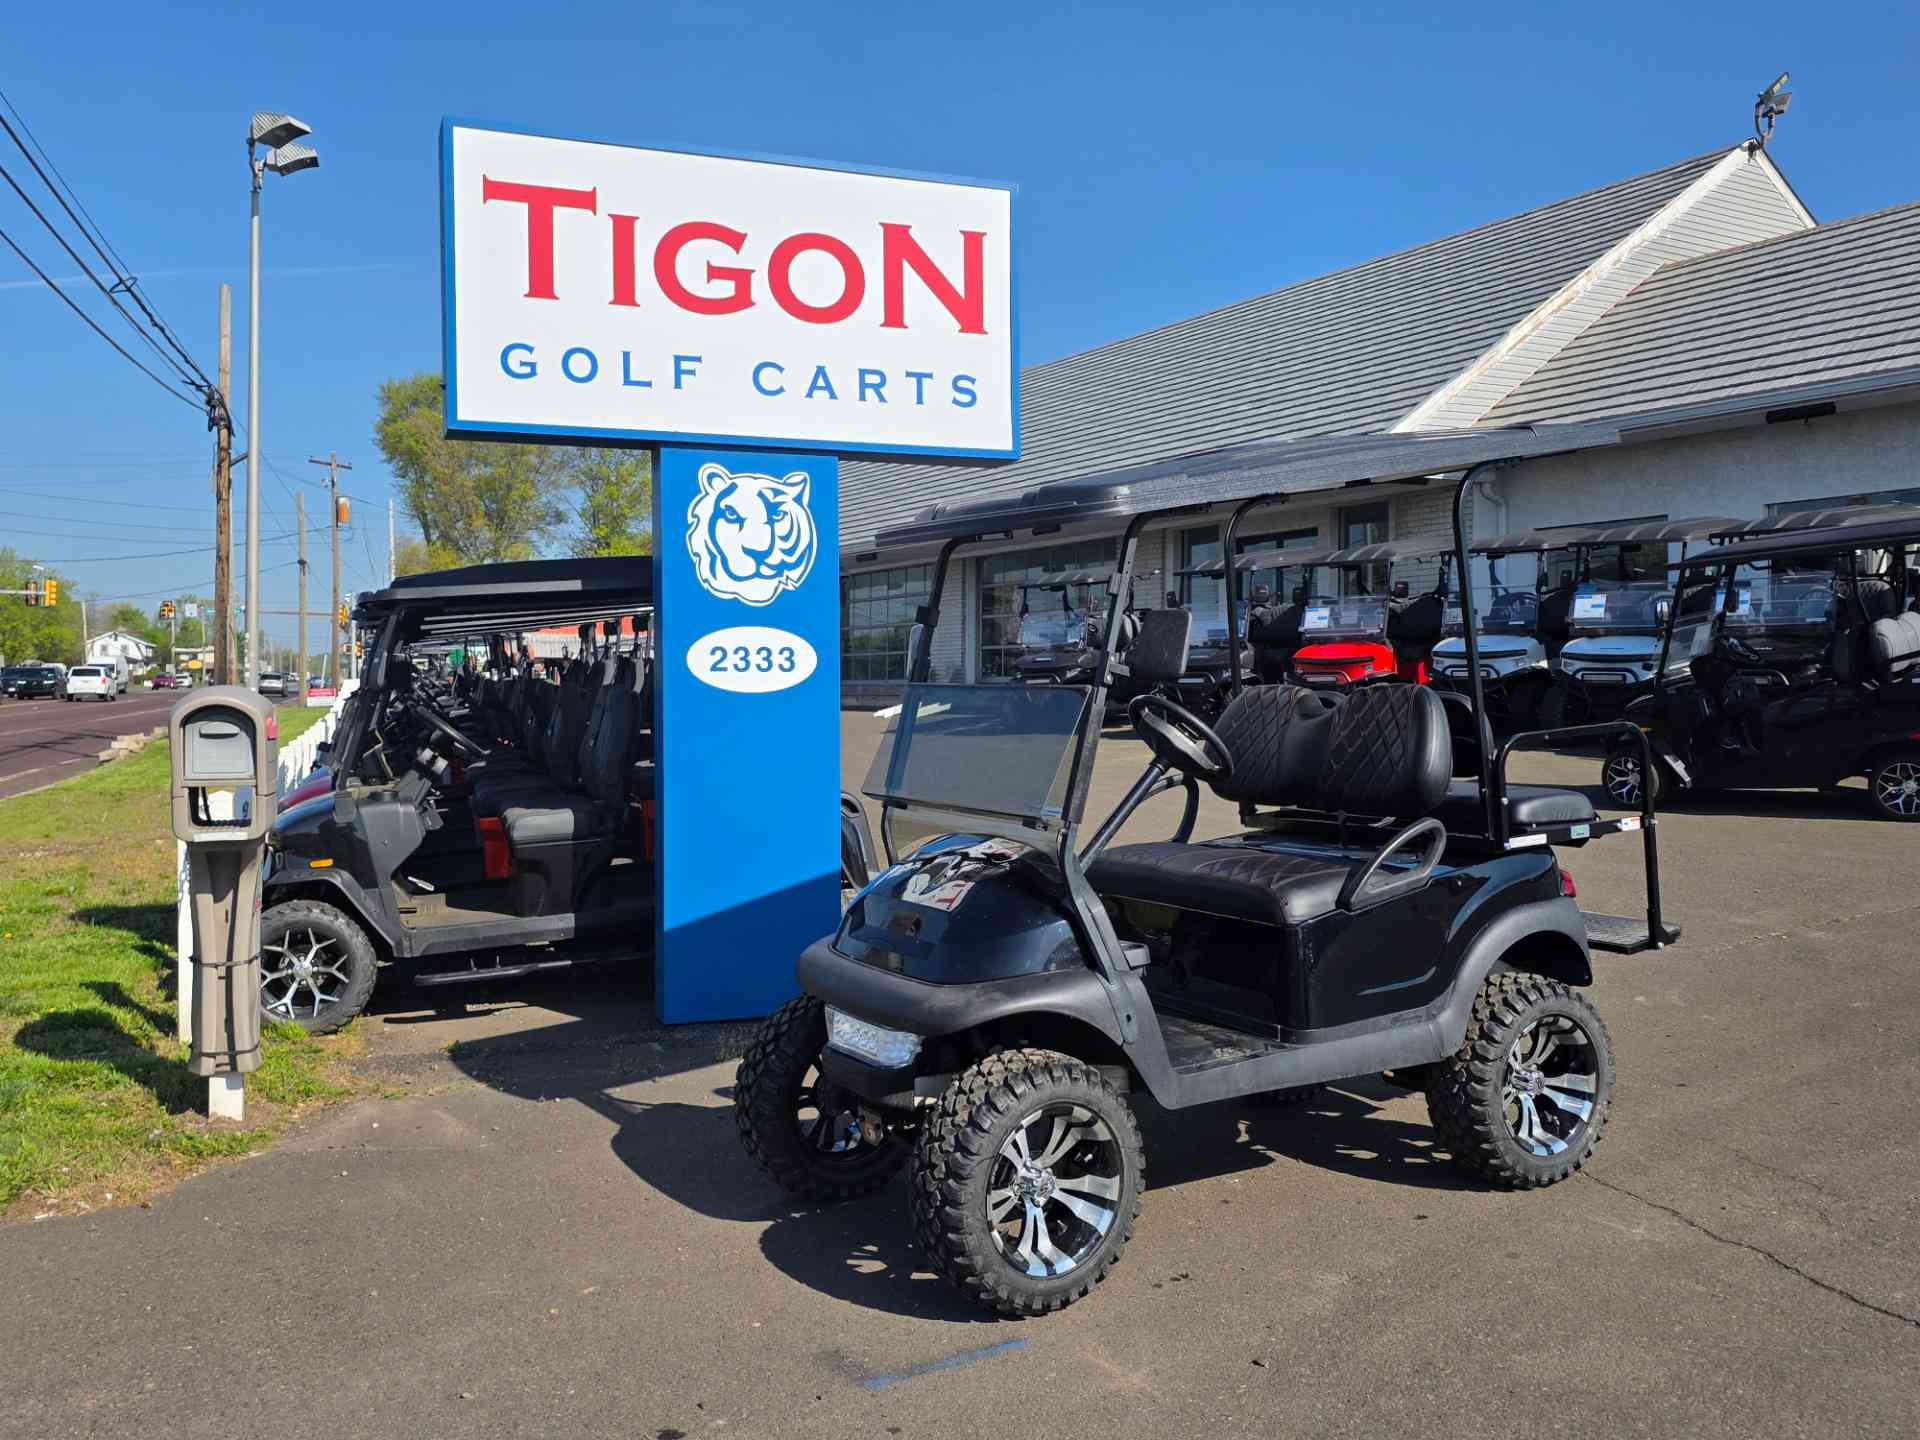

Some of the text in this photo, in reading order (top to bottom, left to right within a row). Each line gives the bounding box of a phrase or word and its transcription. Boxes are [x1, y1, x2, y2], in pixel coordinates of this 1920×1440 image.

[482, 174, 988, 335] TIGON
[499, 342, 978, 409] GOLF CARTS
[708, 645, 797, 673] 2333
